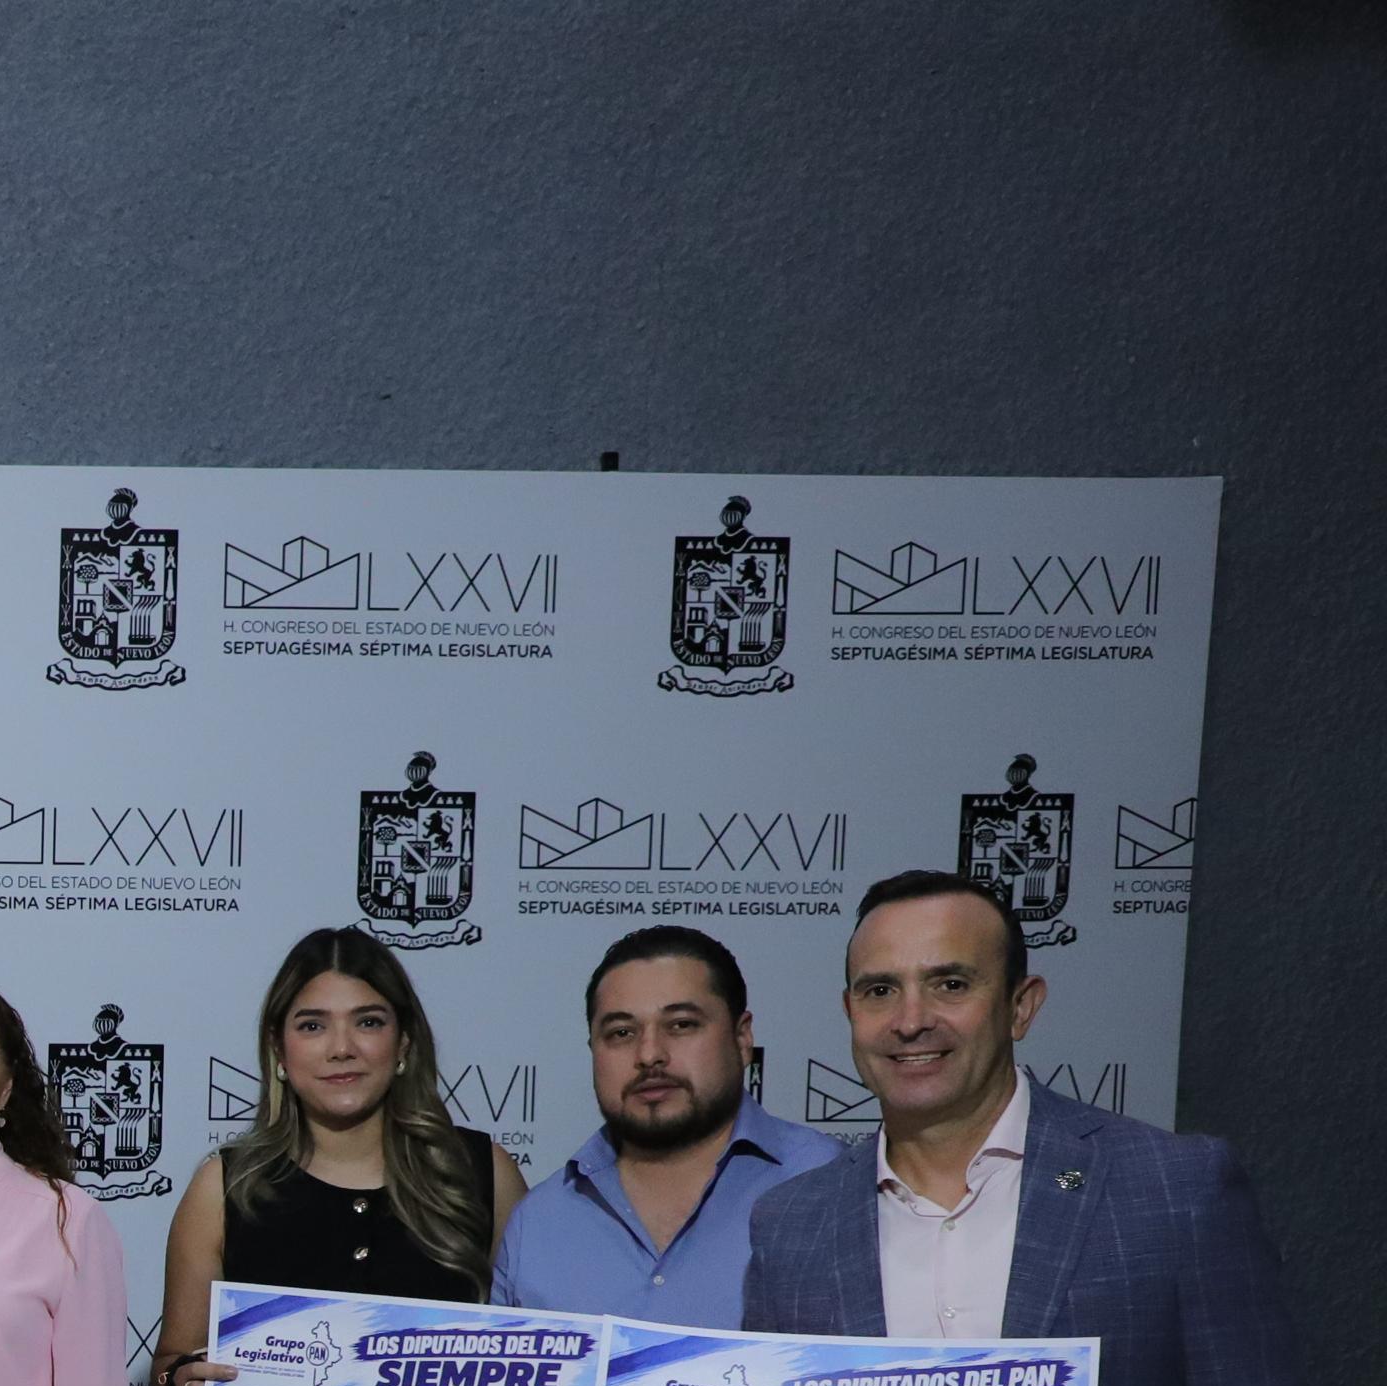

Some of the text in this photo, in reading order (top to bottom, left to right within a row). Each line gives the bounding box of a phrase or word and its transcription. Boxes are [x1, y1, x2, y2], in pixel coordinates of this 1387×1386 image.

[972, 556, 1160, 615] LXXVII
[832, 623, 1156, 639] H. CONGRESO DEL ESTADO DE NUEVO LEÓN
[831, 644, 1153, 660] SEPTUAGÉSIMA SÉPTIMA LEGISLATURA
[659, 813, 846, 871] LXXVII
[519, 878, 843, 895] H. CONGRESO DEL ESTADO DE NUEVO LEÓN
[518, 899, 840, 915] SEPTUAGÉSIMA SÉPTIMA LEGISLATURA
